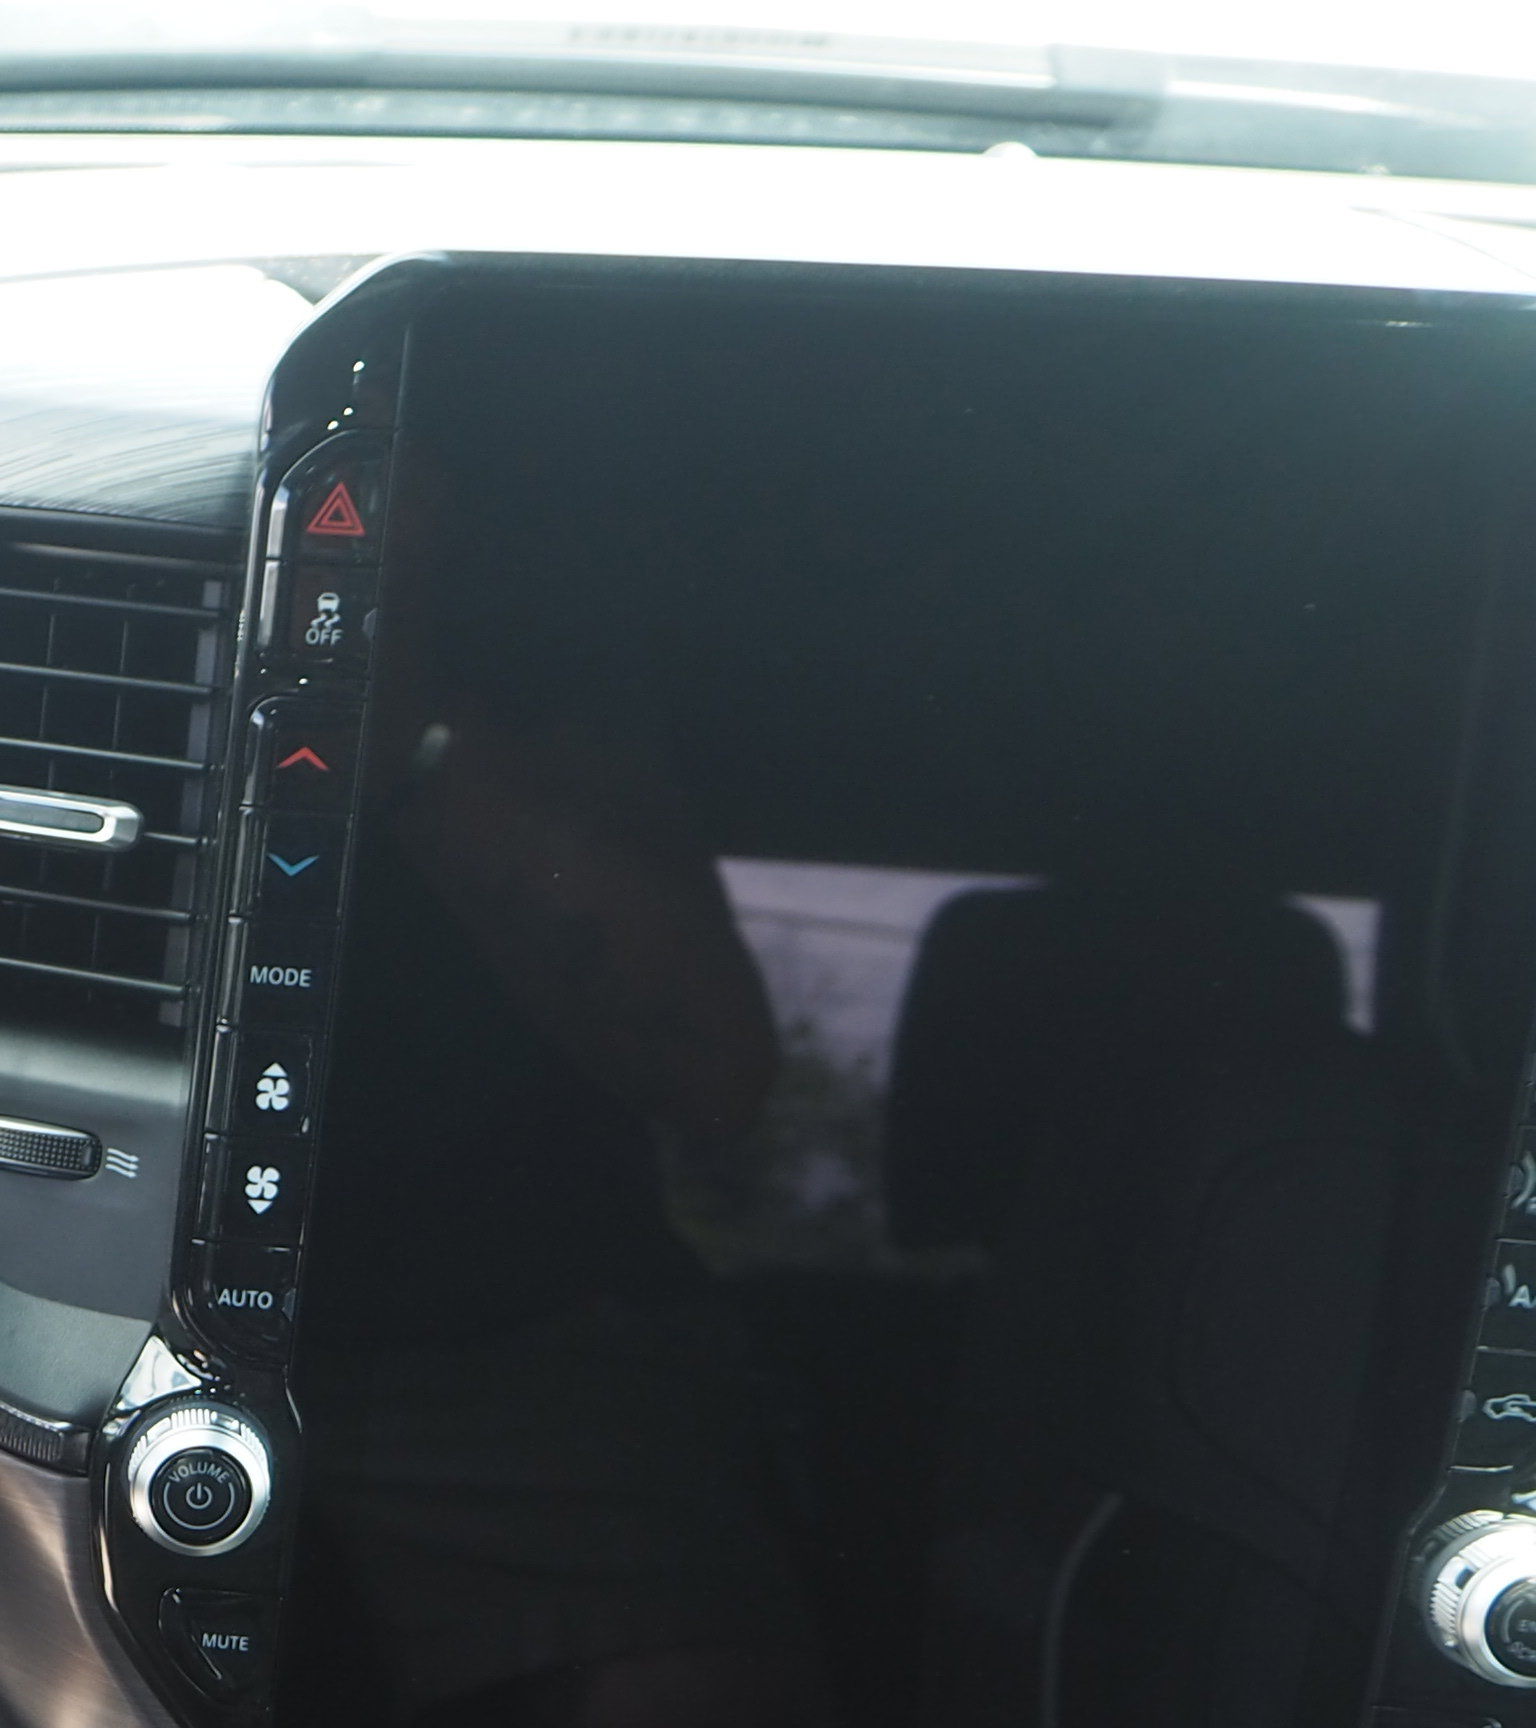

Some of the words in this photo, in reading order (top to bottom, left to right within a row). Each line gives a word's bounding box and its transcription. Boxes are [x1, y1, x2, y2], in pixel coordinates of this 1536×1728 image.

[305, 627, 343, 646] OFF
[250, 965, 312, 988] MODE
[217, 1288, 274, 1311] AUTO
[168, 1461, 230, 1484] VOLUME
[202, 1631, 250, 1651] MUTE
